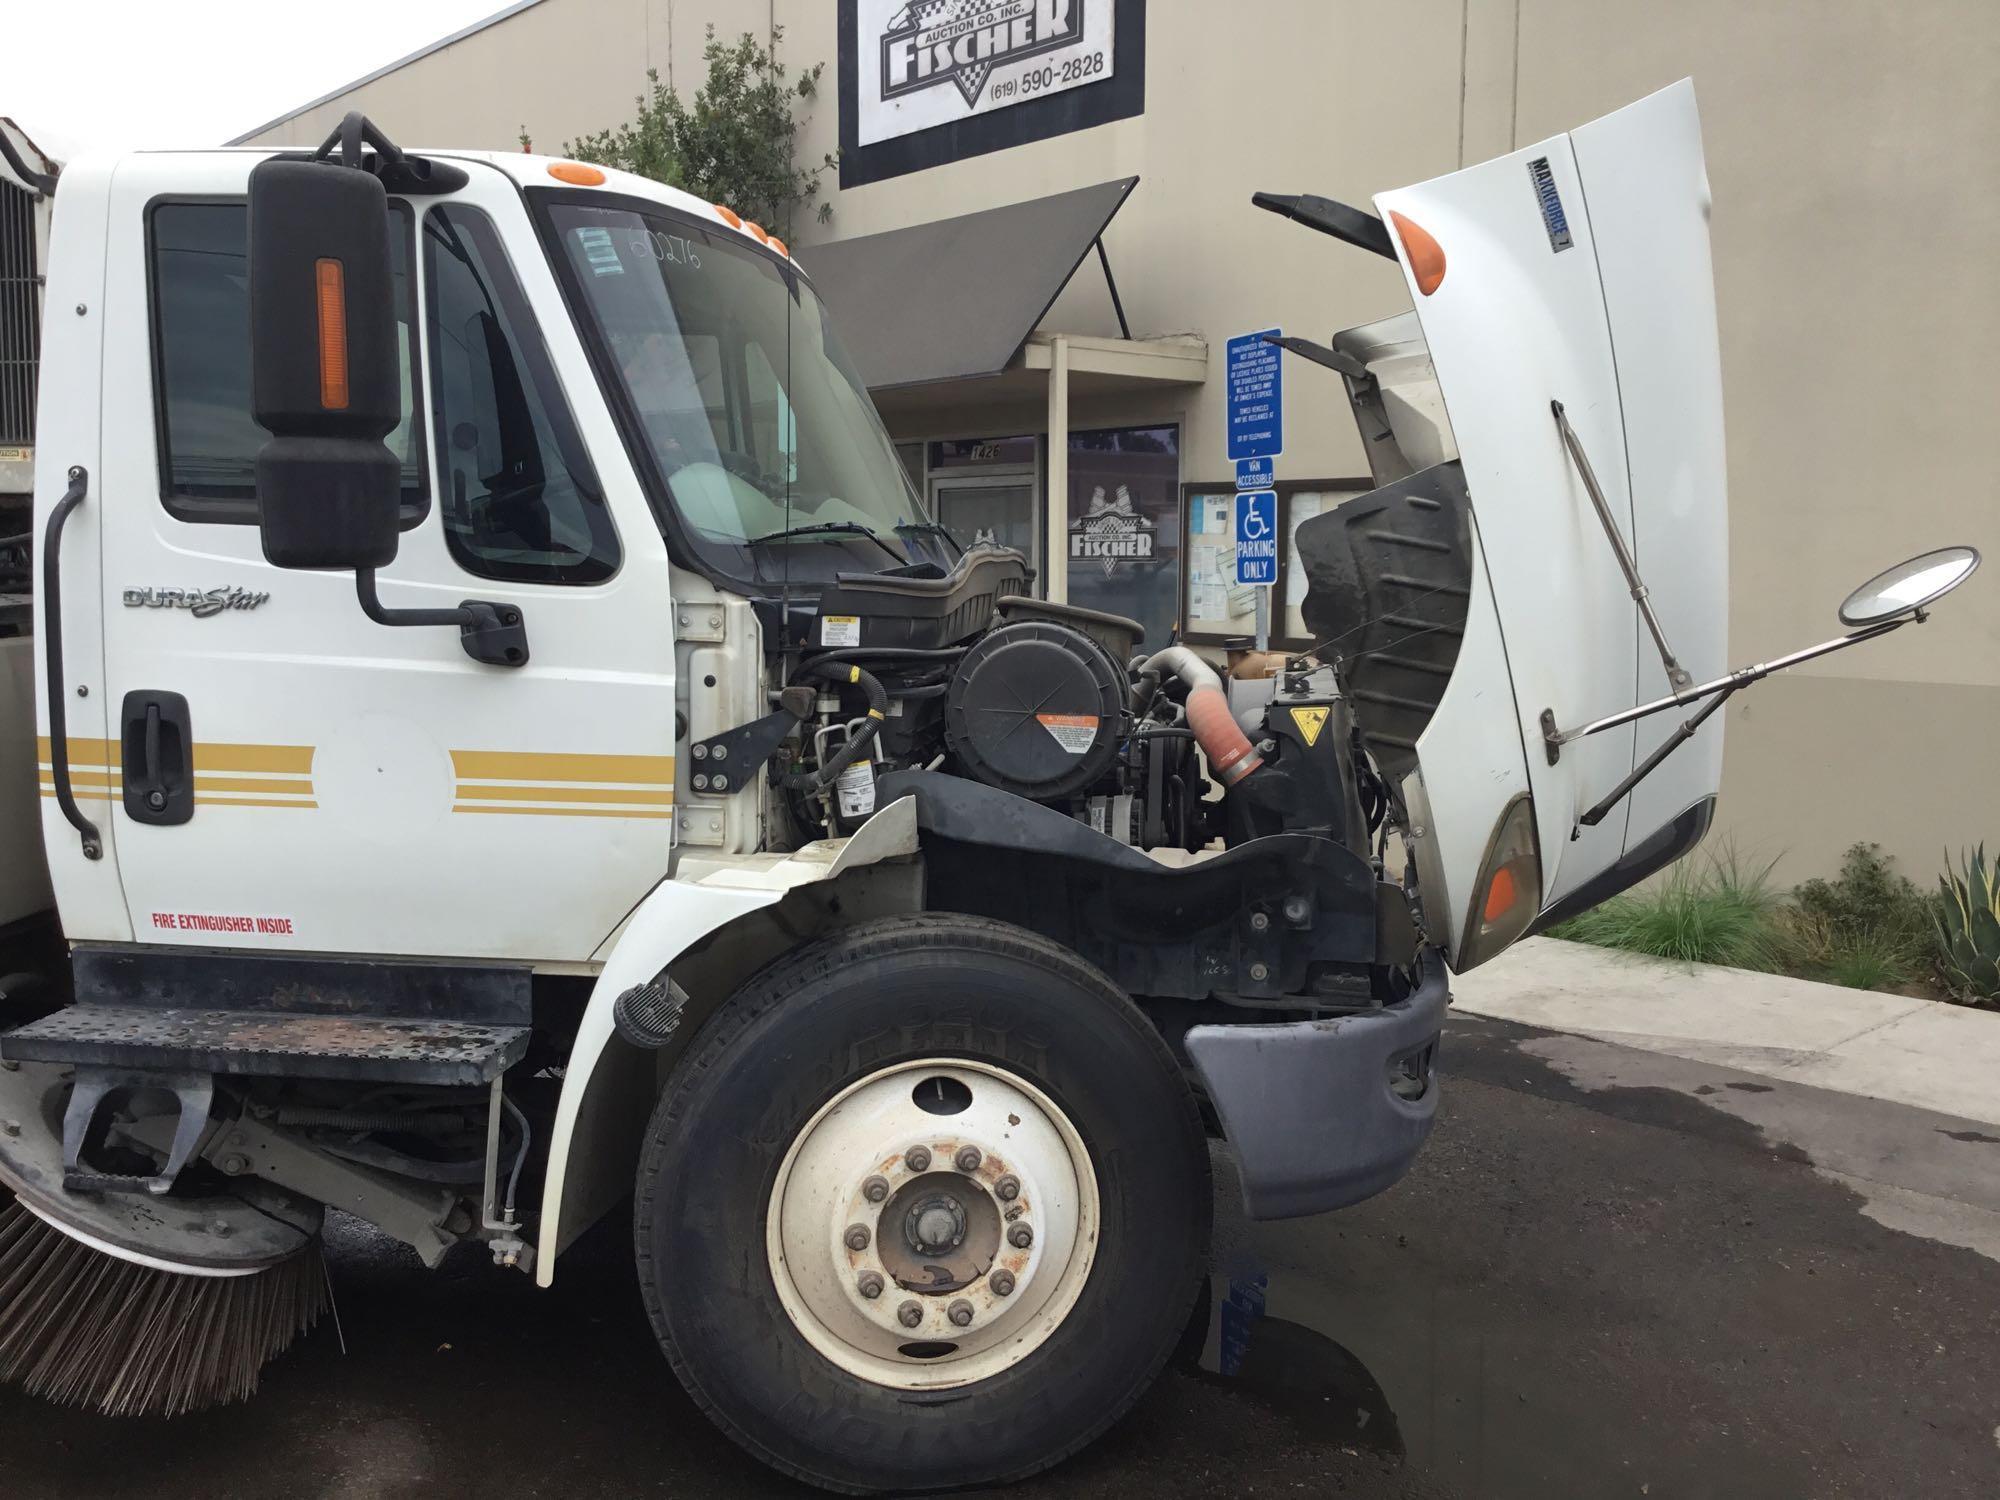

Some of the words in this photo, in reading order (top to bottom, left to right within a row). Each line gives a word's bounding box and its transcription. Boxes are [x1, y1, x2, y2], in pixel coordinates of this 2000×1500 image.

[925, 20, 974, 44] AUCTION
[977, 12, 997, 26] CO.
[1000, 4, 1025, 20] INC.
[889, 0, 1071, 87] FISCHER
[990, 80, 1018, 102] (619)
[1021, 52, 1104, 94] 590-2828
[1532, 156, 1569, 235] MAXXFORCE
[973, 444, 1001, 459] 1426
[1248, 460, 1261, 472] VAN
[1237, 472, 1273, 486] ACCESSIBLE
[1071, 533, 1152, 556] FISCHER
[1237, 540, 1275, 558] PARKING
[1243, 561, 1268, 579] ONLY
[152, 913, 177, 929] FIRE
[177, 914, 255, 933] EXTINGUISHER
[256, 918, 294, 934] INSIDE
